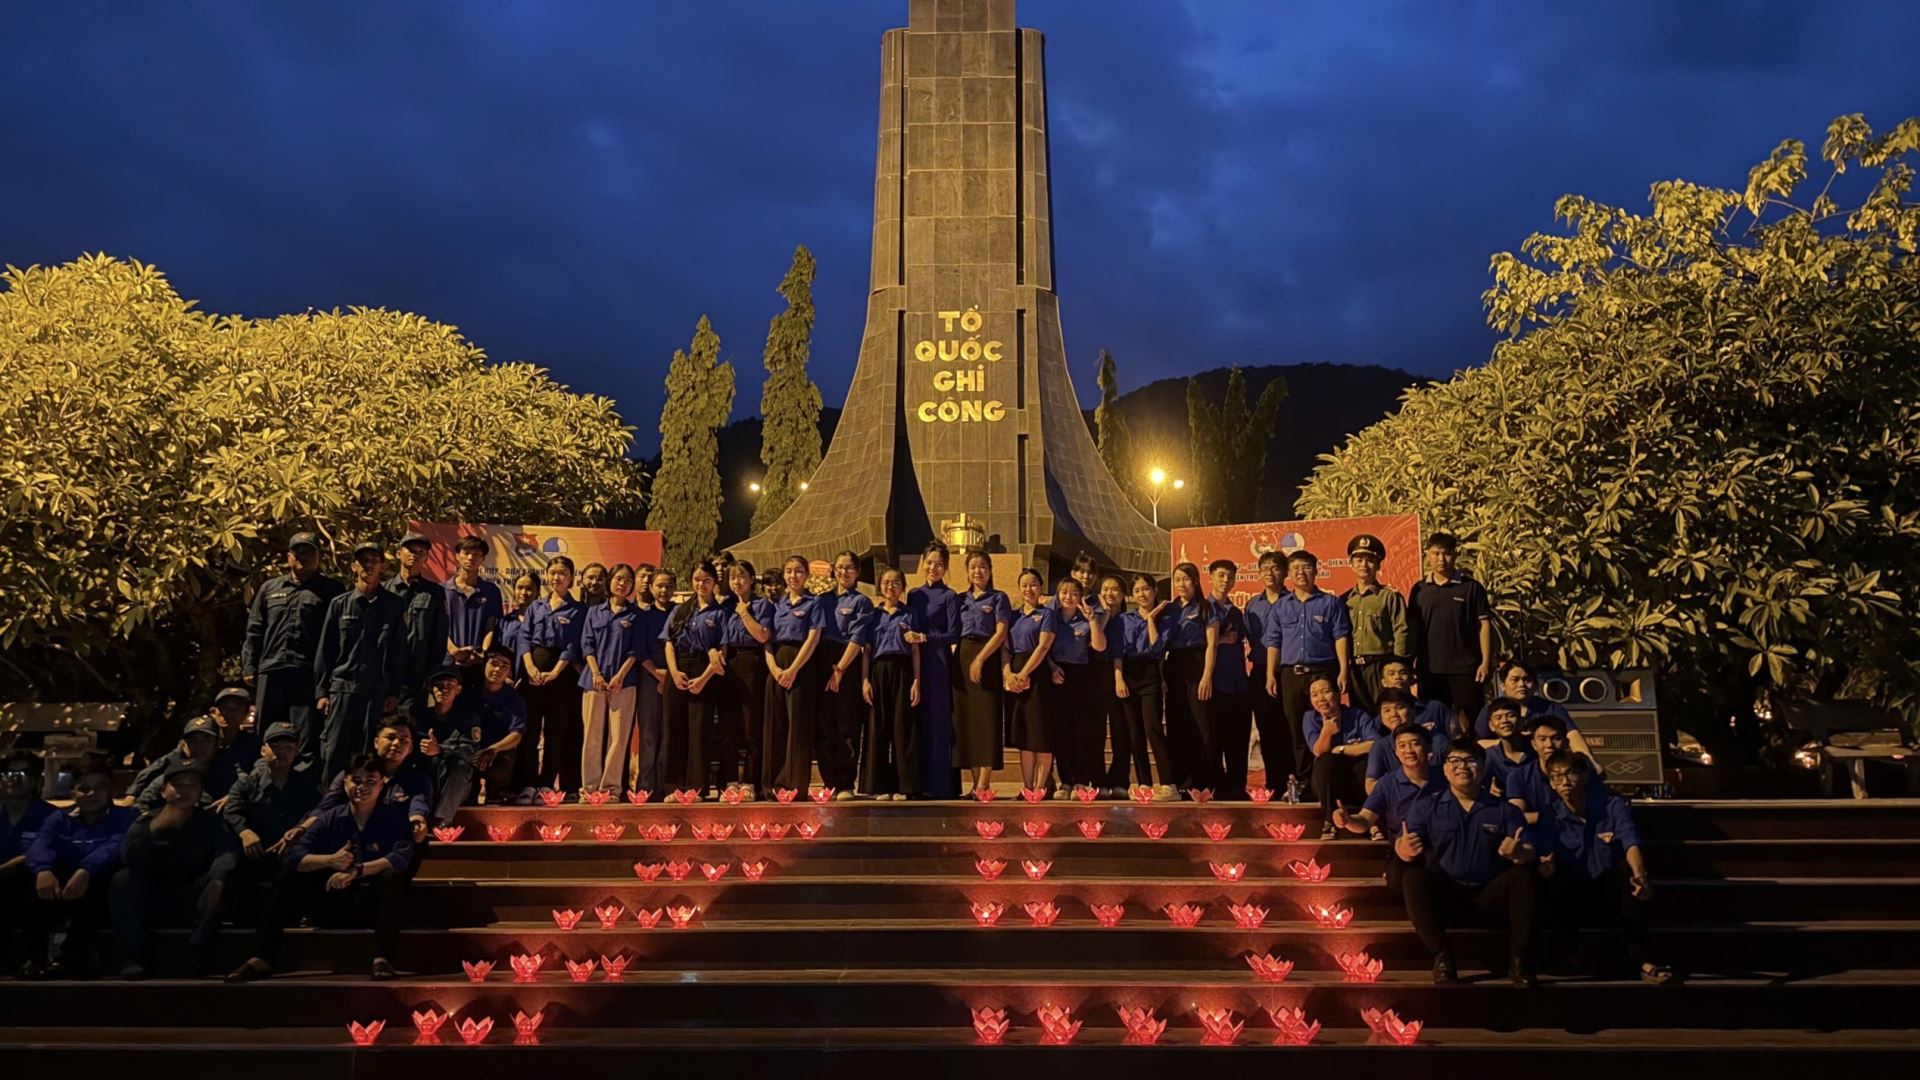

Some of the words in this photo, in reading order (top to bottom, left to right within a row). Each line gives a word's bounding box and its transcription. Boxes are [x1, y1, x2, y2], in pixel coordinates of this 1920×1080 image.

[938, 304, 983, 332] TỔ
[914, 334, 1004, 362] QUỐC
[918, 396, 1006, 423] CÔNG
